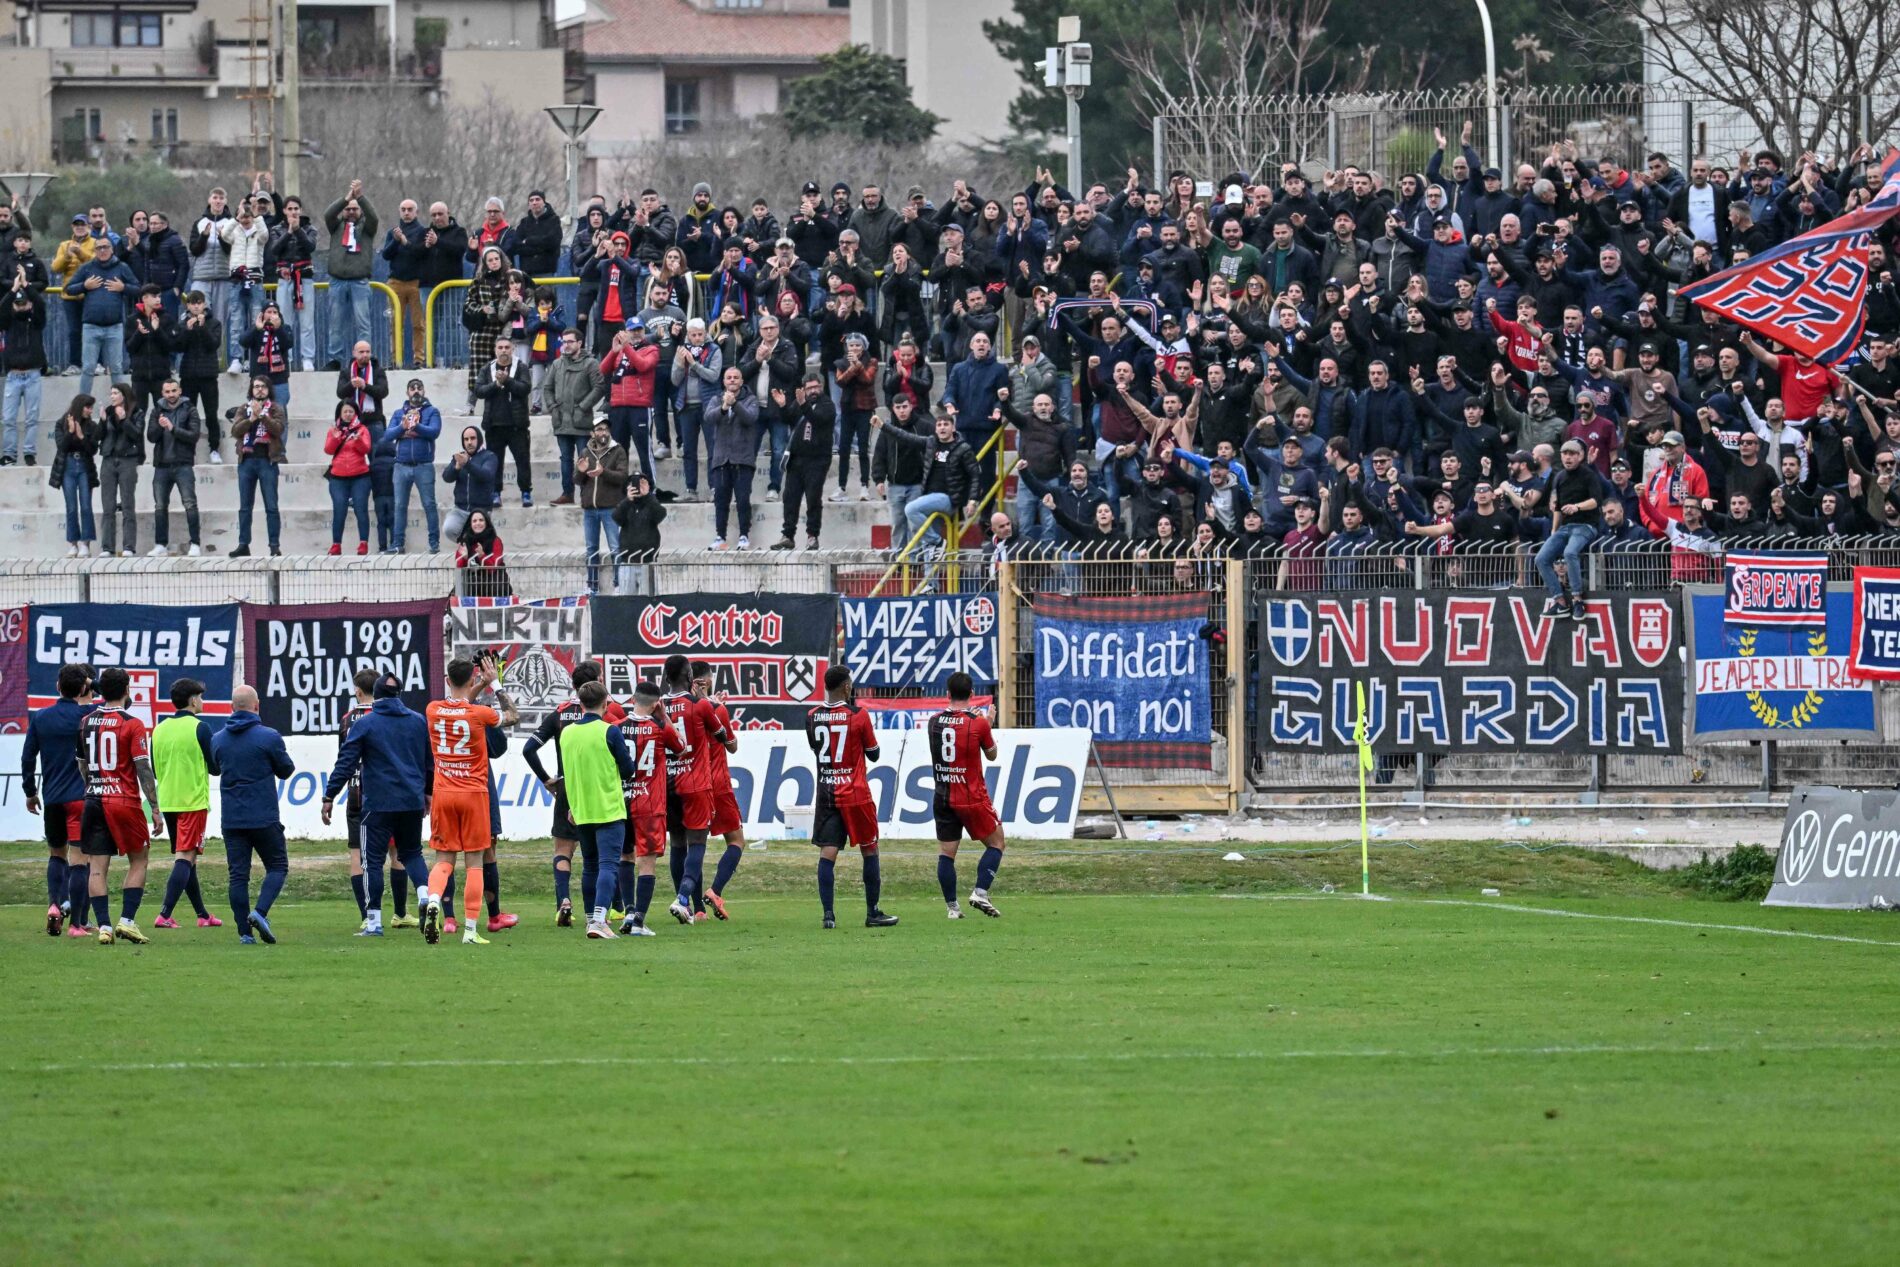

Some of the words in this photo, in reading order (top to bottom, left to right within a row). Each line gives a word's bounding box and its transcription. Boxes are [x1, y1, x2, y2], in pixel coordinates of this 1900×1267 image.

[1730, 564, 1822, 613] SERPENTE
[452, 607, 584, 642] NORTH
[638, 601, 783, 648] Centro
[843, 600, 930, 638] MADE
[935, 598, 962, 638] IN
[1318, 596, 1622, 668] NUOVA
[36, 614, 231, 666] Casuals
[268, 620, 327, 658] DAL
[343, 619, 412, 655] 1989
[1040, 627, 1195, 679] Diffidati
[1871, 630, 1900, 658] TE
[267, 659, 287, 697] A
[847, 636, 999, 684] SASSARI
[1698, 658, 1778, 692] SEMPER
[640, 662, 780, 698] TARI
[87, 717, 118, 727] MASTINU
[291, 697, 358, 732] DELL
[621, 725, 653, 735] GIORICO
[813, 712, 847, 722] ZAMBATARO
[938, 715, 964, 725] MASALA
[1047, 697, 1116, 734] con
[1139, 689, 1192, 734] noi
[1270, 676, 1670, 748] GUARDIA
[85, 730, 118, 772] 10
[434, 718, 471, 755] 12
[814, 725, 849, 763] 27
[941, 727, 956, 763] 8
